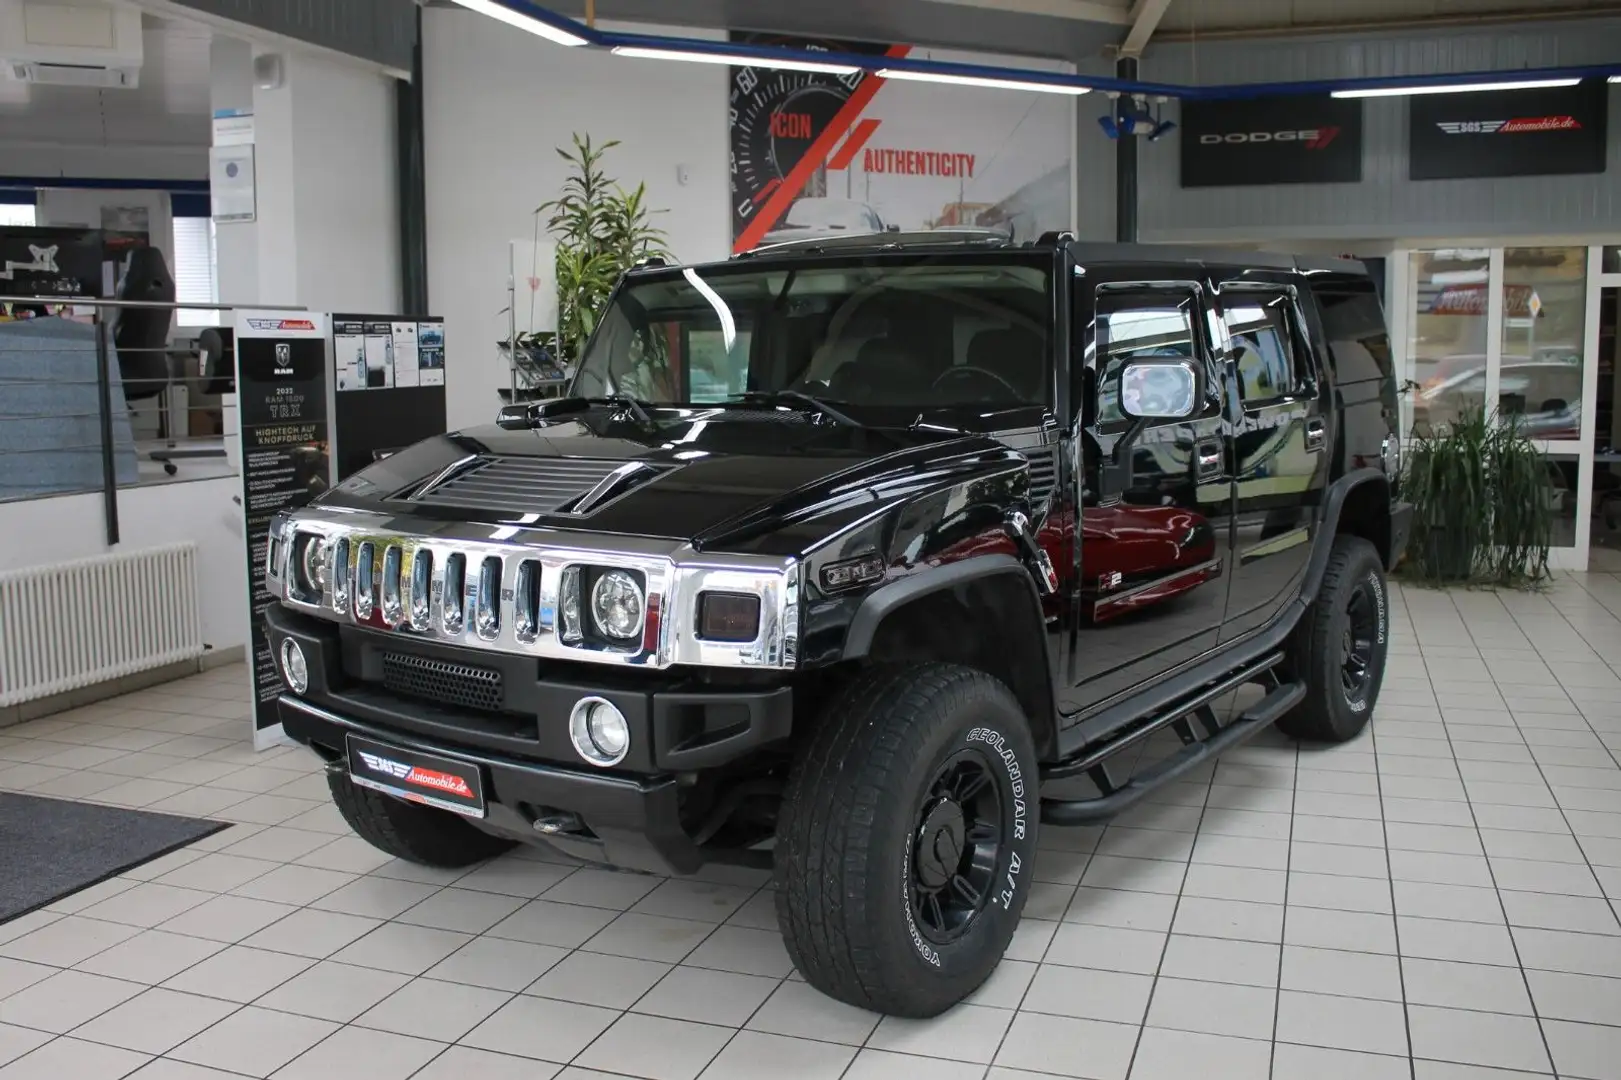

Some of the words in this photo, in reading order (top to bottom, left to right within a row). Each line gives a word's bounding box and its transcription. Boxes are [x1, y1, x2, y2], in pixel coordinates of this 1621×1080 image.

[770, 112, 812, 139] ICON
[1460, 121, 1481, 133] SGS
[1500, 115, 1576, 133] Automobile.de
[1200, 129, 1320, 145] DODGE
[863, 147, 976, 179] AUTHENTICITY
[269, 404, 301, 418] TRX
[255, 426, 299, 437] HIGHTECH
[406, 769, 468, 792] Automobile.de
[966, 728, 1026, 839] GEOLANDAR
